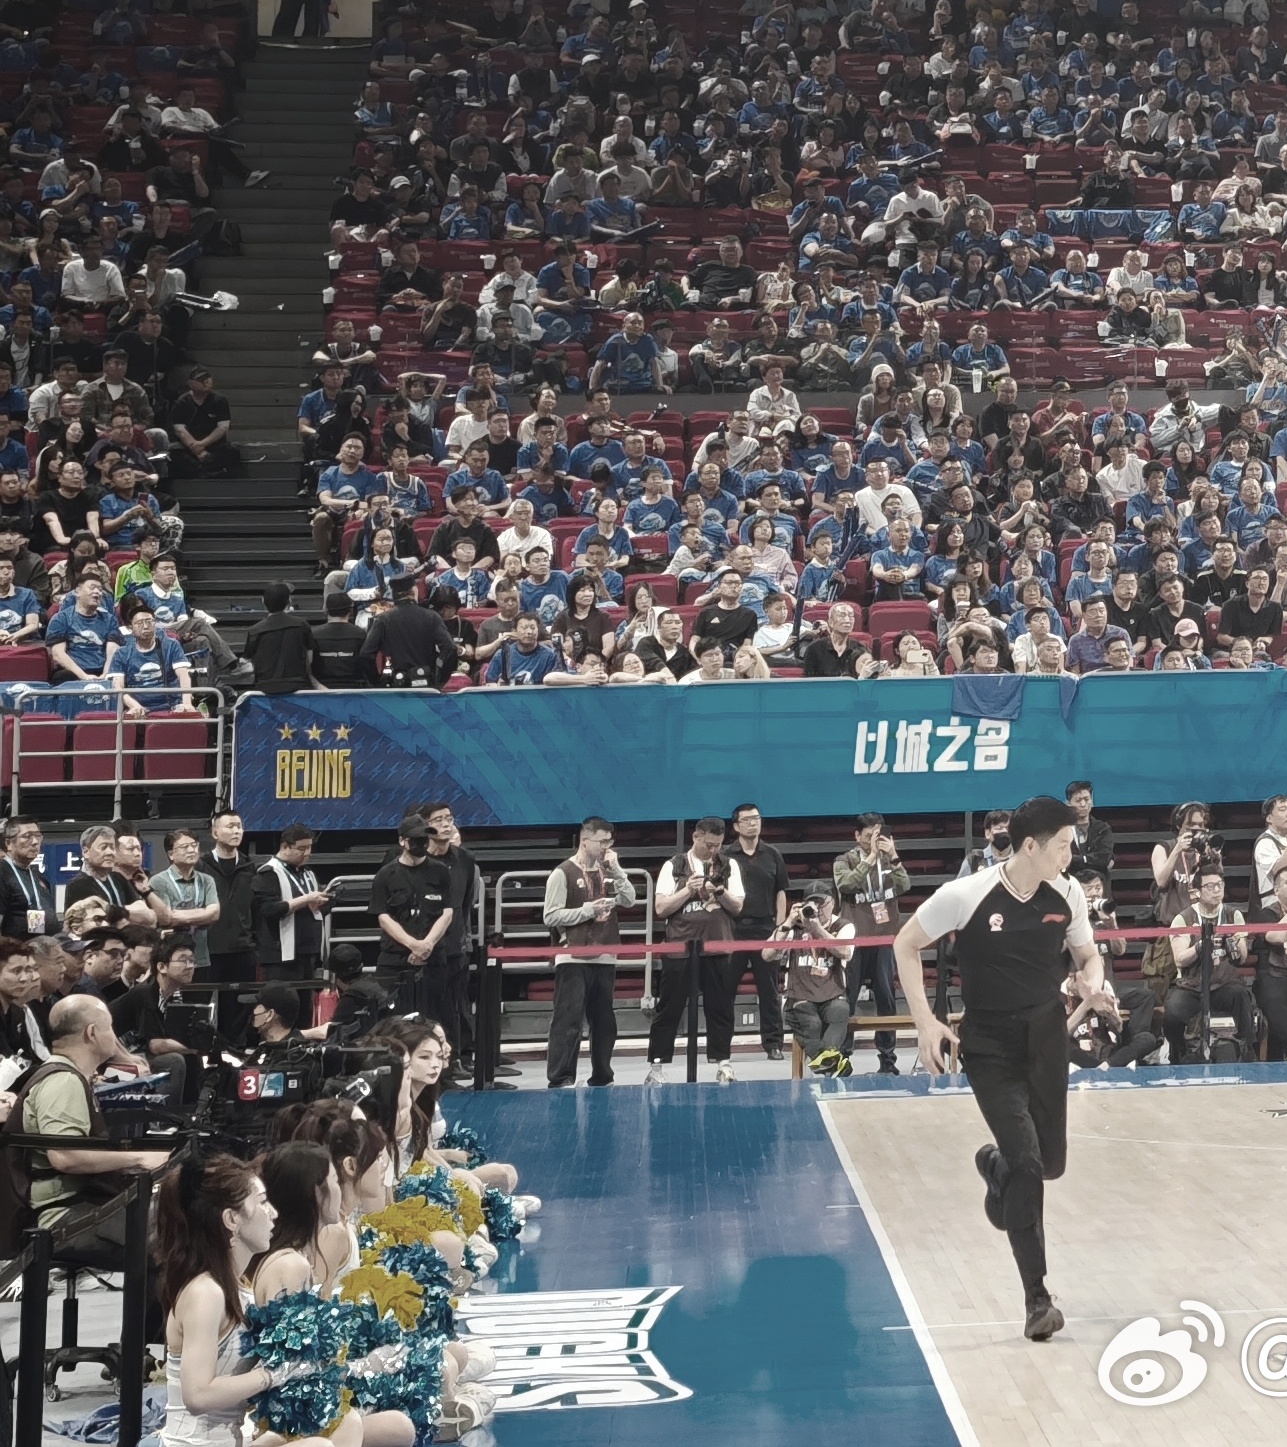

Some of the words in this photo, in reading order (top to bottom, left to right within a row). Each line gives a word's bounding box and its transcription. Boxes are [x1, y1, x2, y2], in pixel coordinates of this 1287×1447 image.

[854, 718, 1011, 774] 以城之名
[276, 748, 352, 800] BEIJING
[244, 1076, 256, 1095] 3
